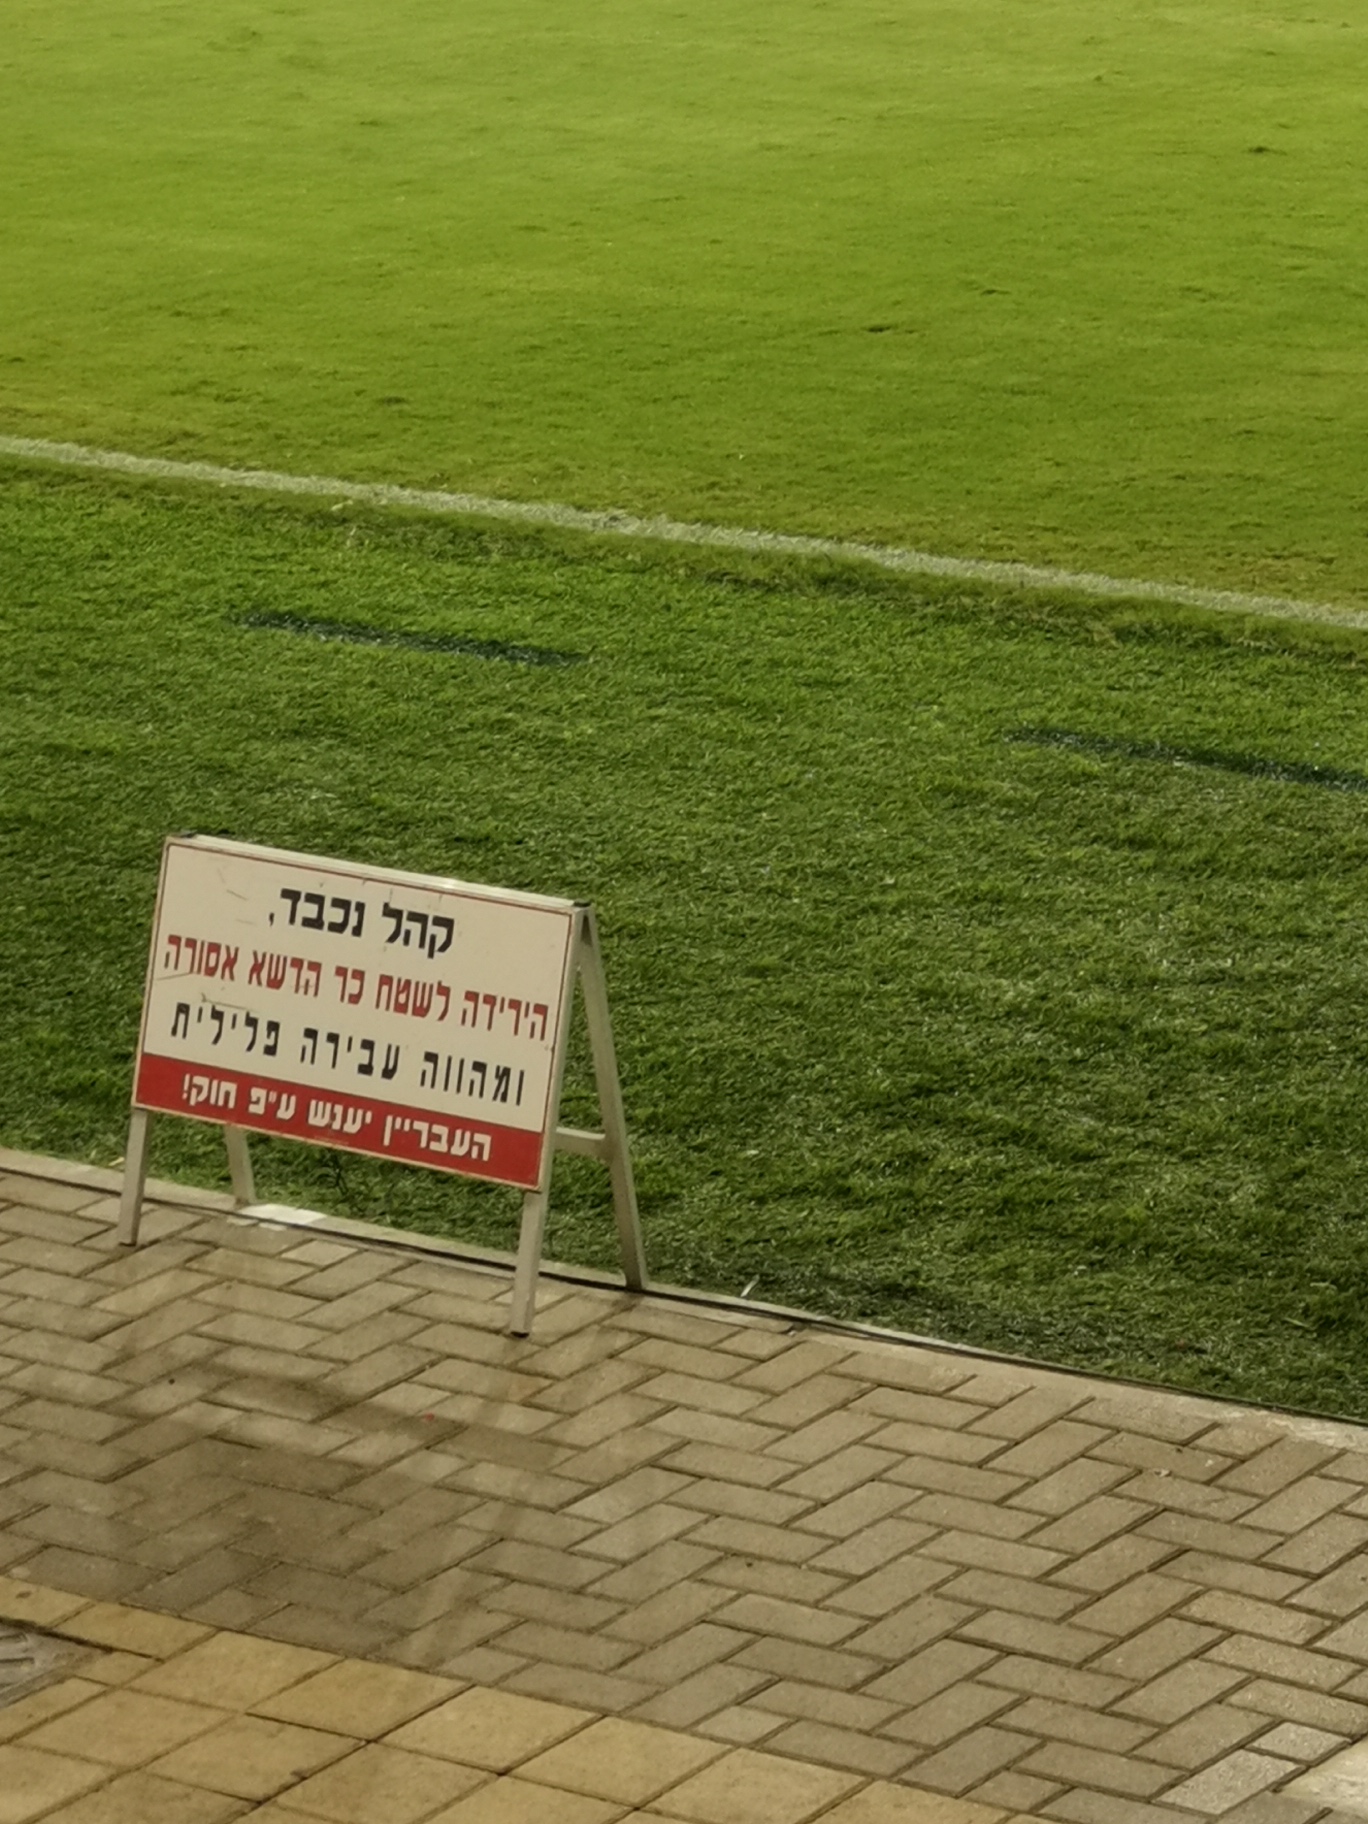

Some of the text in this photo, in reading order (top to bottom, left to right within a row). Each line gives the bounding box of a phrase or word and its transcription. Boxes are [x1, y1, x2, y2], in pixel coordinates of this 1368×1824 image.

[268, 888, 455, 959] קהל נכבד,
[164, 933, 549, 1042] הירידה לשטח כר הדשא אסורה
[171, 1002, 525, 1107] ומהווה עבירה פלילית
[182, 1073, 238, 1110] חוק!
[307, 1097, 373, 1135] יענש
[383, 1114, 492, 1162] העבריין
